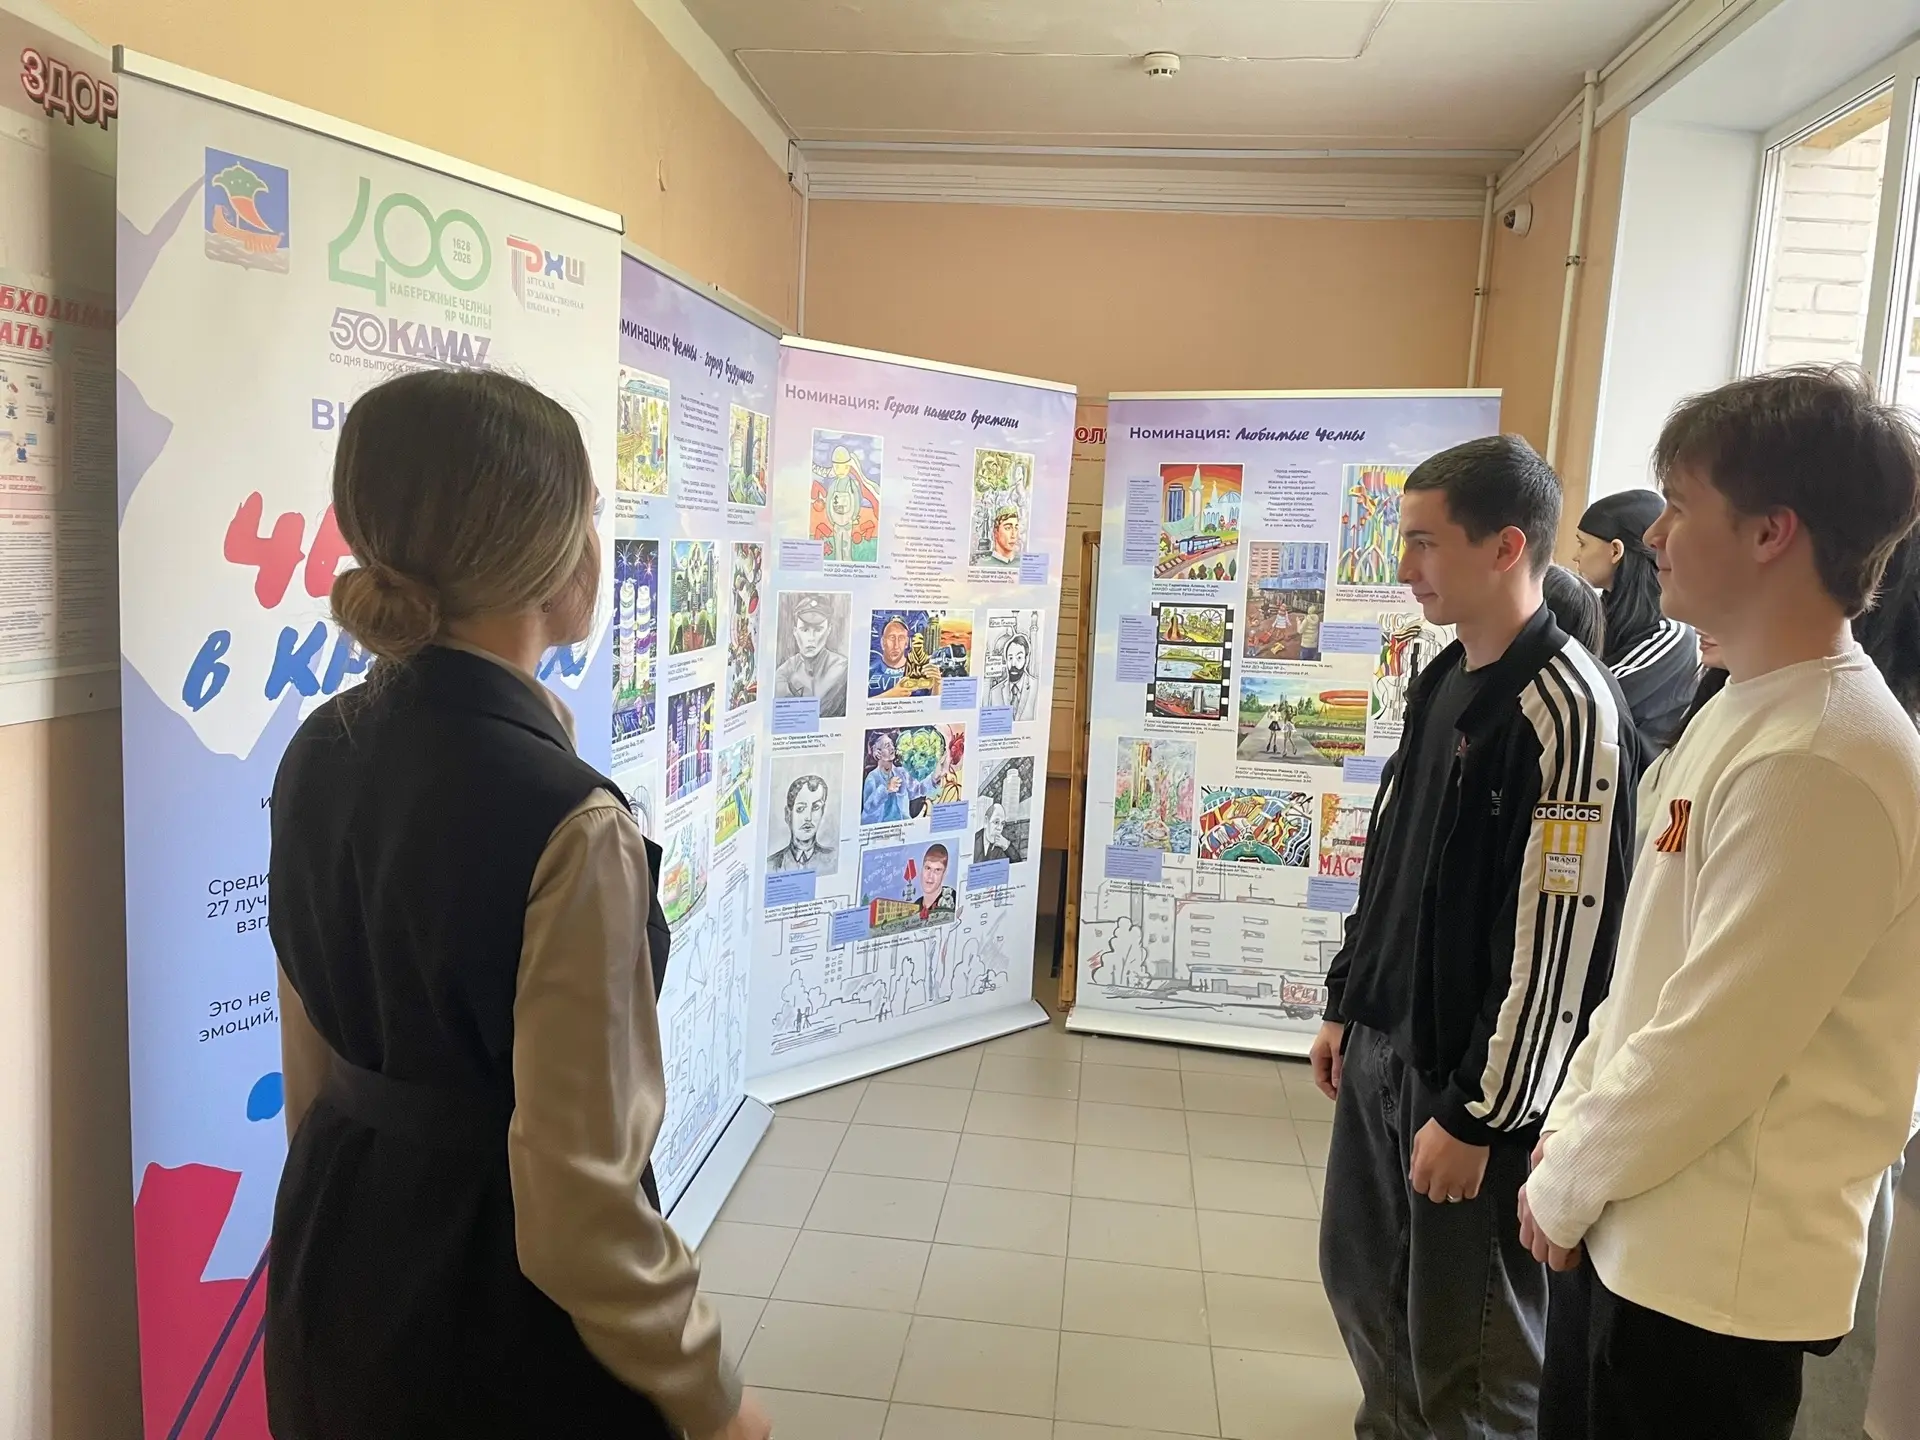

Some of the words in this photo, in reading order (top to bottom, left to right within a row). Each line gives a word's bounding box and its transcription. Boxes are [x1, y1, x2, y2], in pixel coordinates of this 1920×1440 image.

[389, 281, 458, 307] НАБЕРЕЖНЫЕ
[459, 298, 492, 316] ЧЕЛНЫ
[444, 310, 457, 323] ЯР
[458, 313, 492, 330] ЧАЛЛЫ
[388, 317, 491, 370] KAMAZ
[329, 352, 342, 363] СО
[343, 355, 361, 368] ДНЯ
[672, 332, 698, 362] Челны
[704, 351, 724, 379] город
[725, 357, 755, 386] будущего
[785, 383, 880, 410] Номинация:
[883, 395, 919, 420] Герои
[923, 404, 967, 421] нашего
[970, 408, 1020, 429] времени
[1129, 427, 1231, 440] Номинация:
[1235, 427, 1310, 442] Любимые
[1315, 427, 1366, 442] Челны
[1534, 804, 1600, 821] adidas
[206, 900, 229, 918] 27
[208, 998, 242, 1018] Это
[248, 989, 271, 1007] не
[199, 1007, 279, 1042] эмоций,
